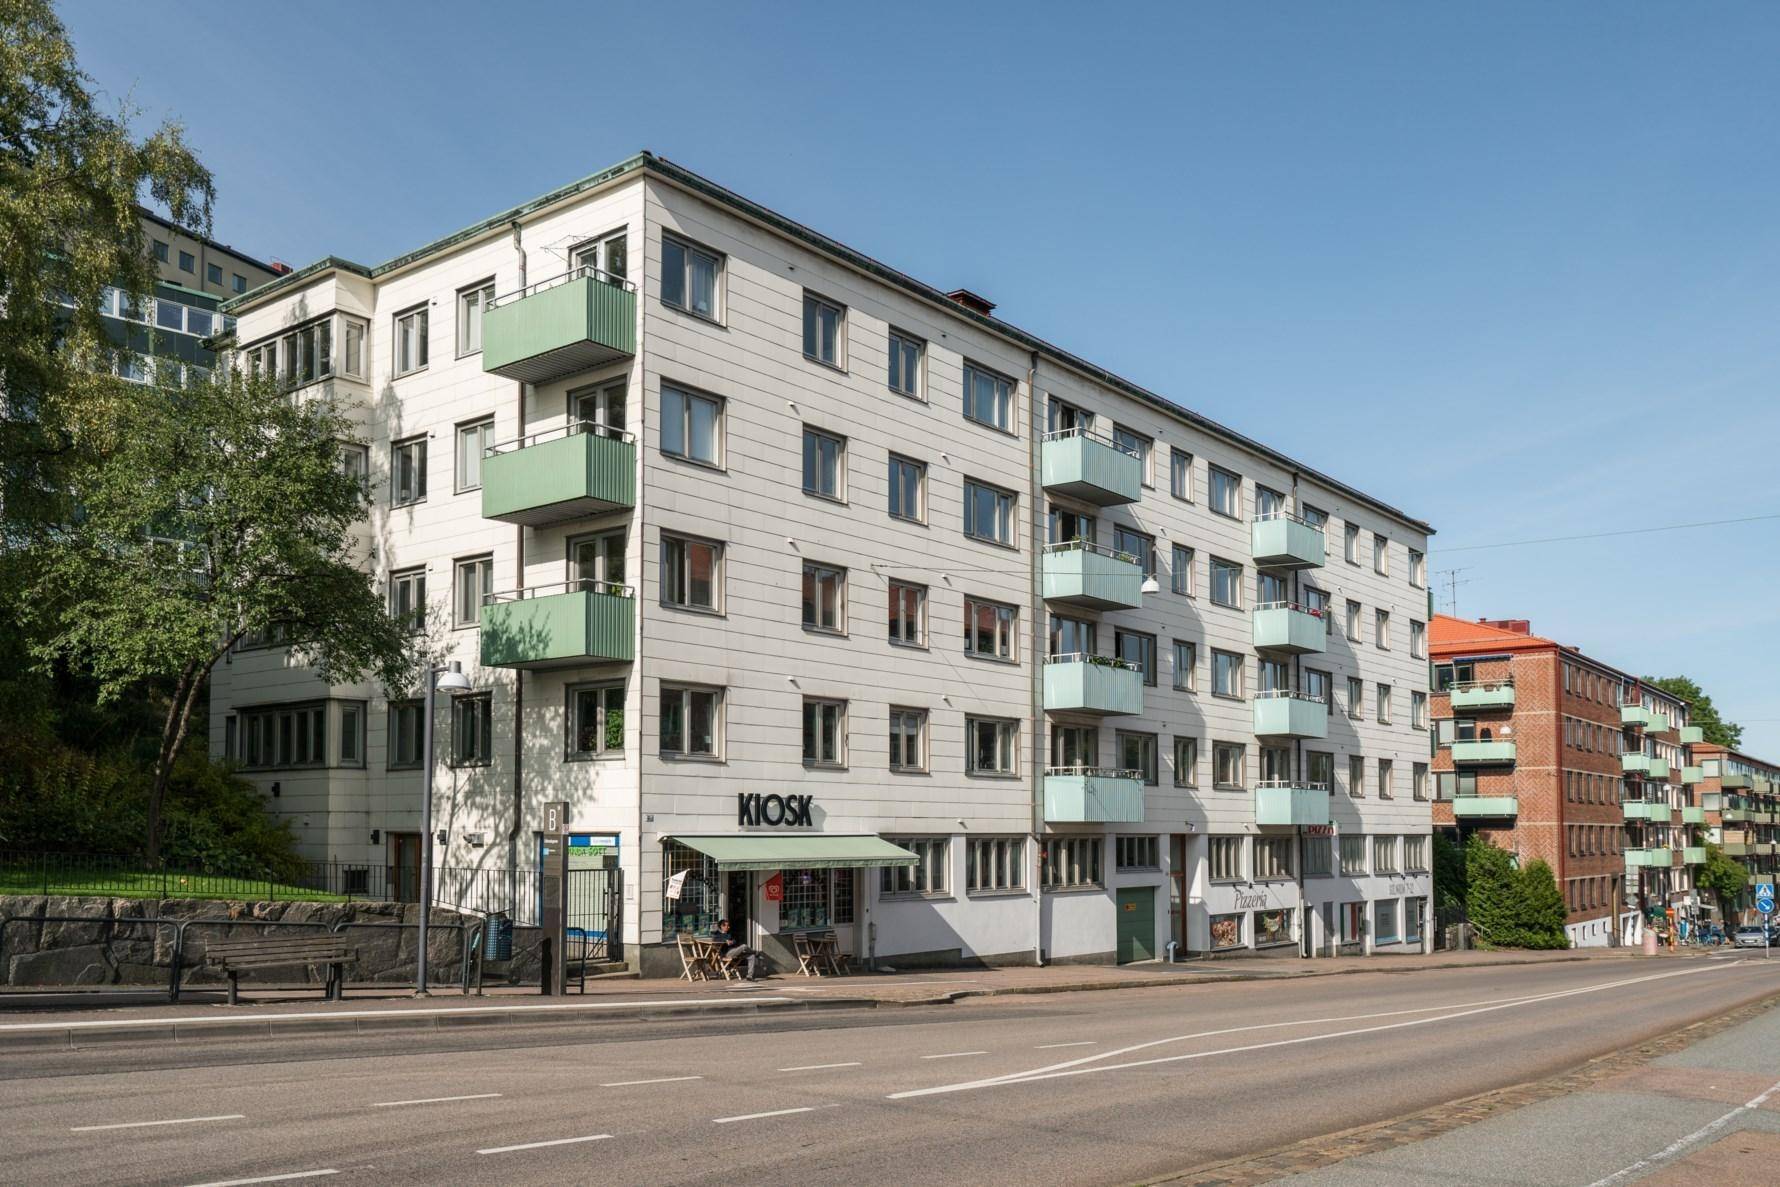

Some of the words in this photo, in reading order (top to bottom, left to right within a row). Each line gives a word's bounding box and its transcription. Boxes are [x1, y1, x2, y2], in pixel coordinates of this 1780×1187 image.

[549, 809, 556, 831] B
[738, 792, 813, 826] KIOSK
[1234, 891, 1267, 909] Pizzeria
